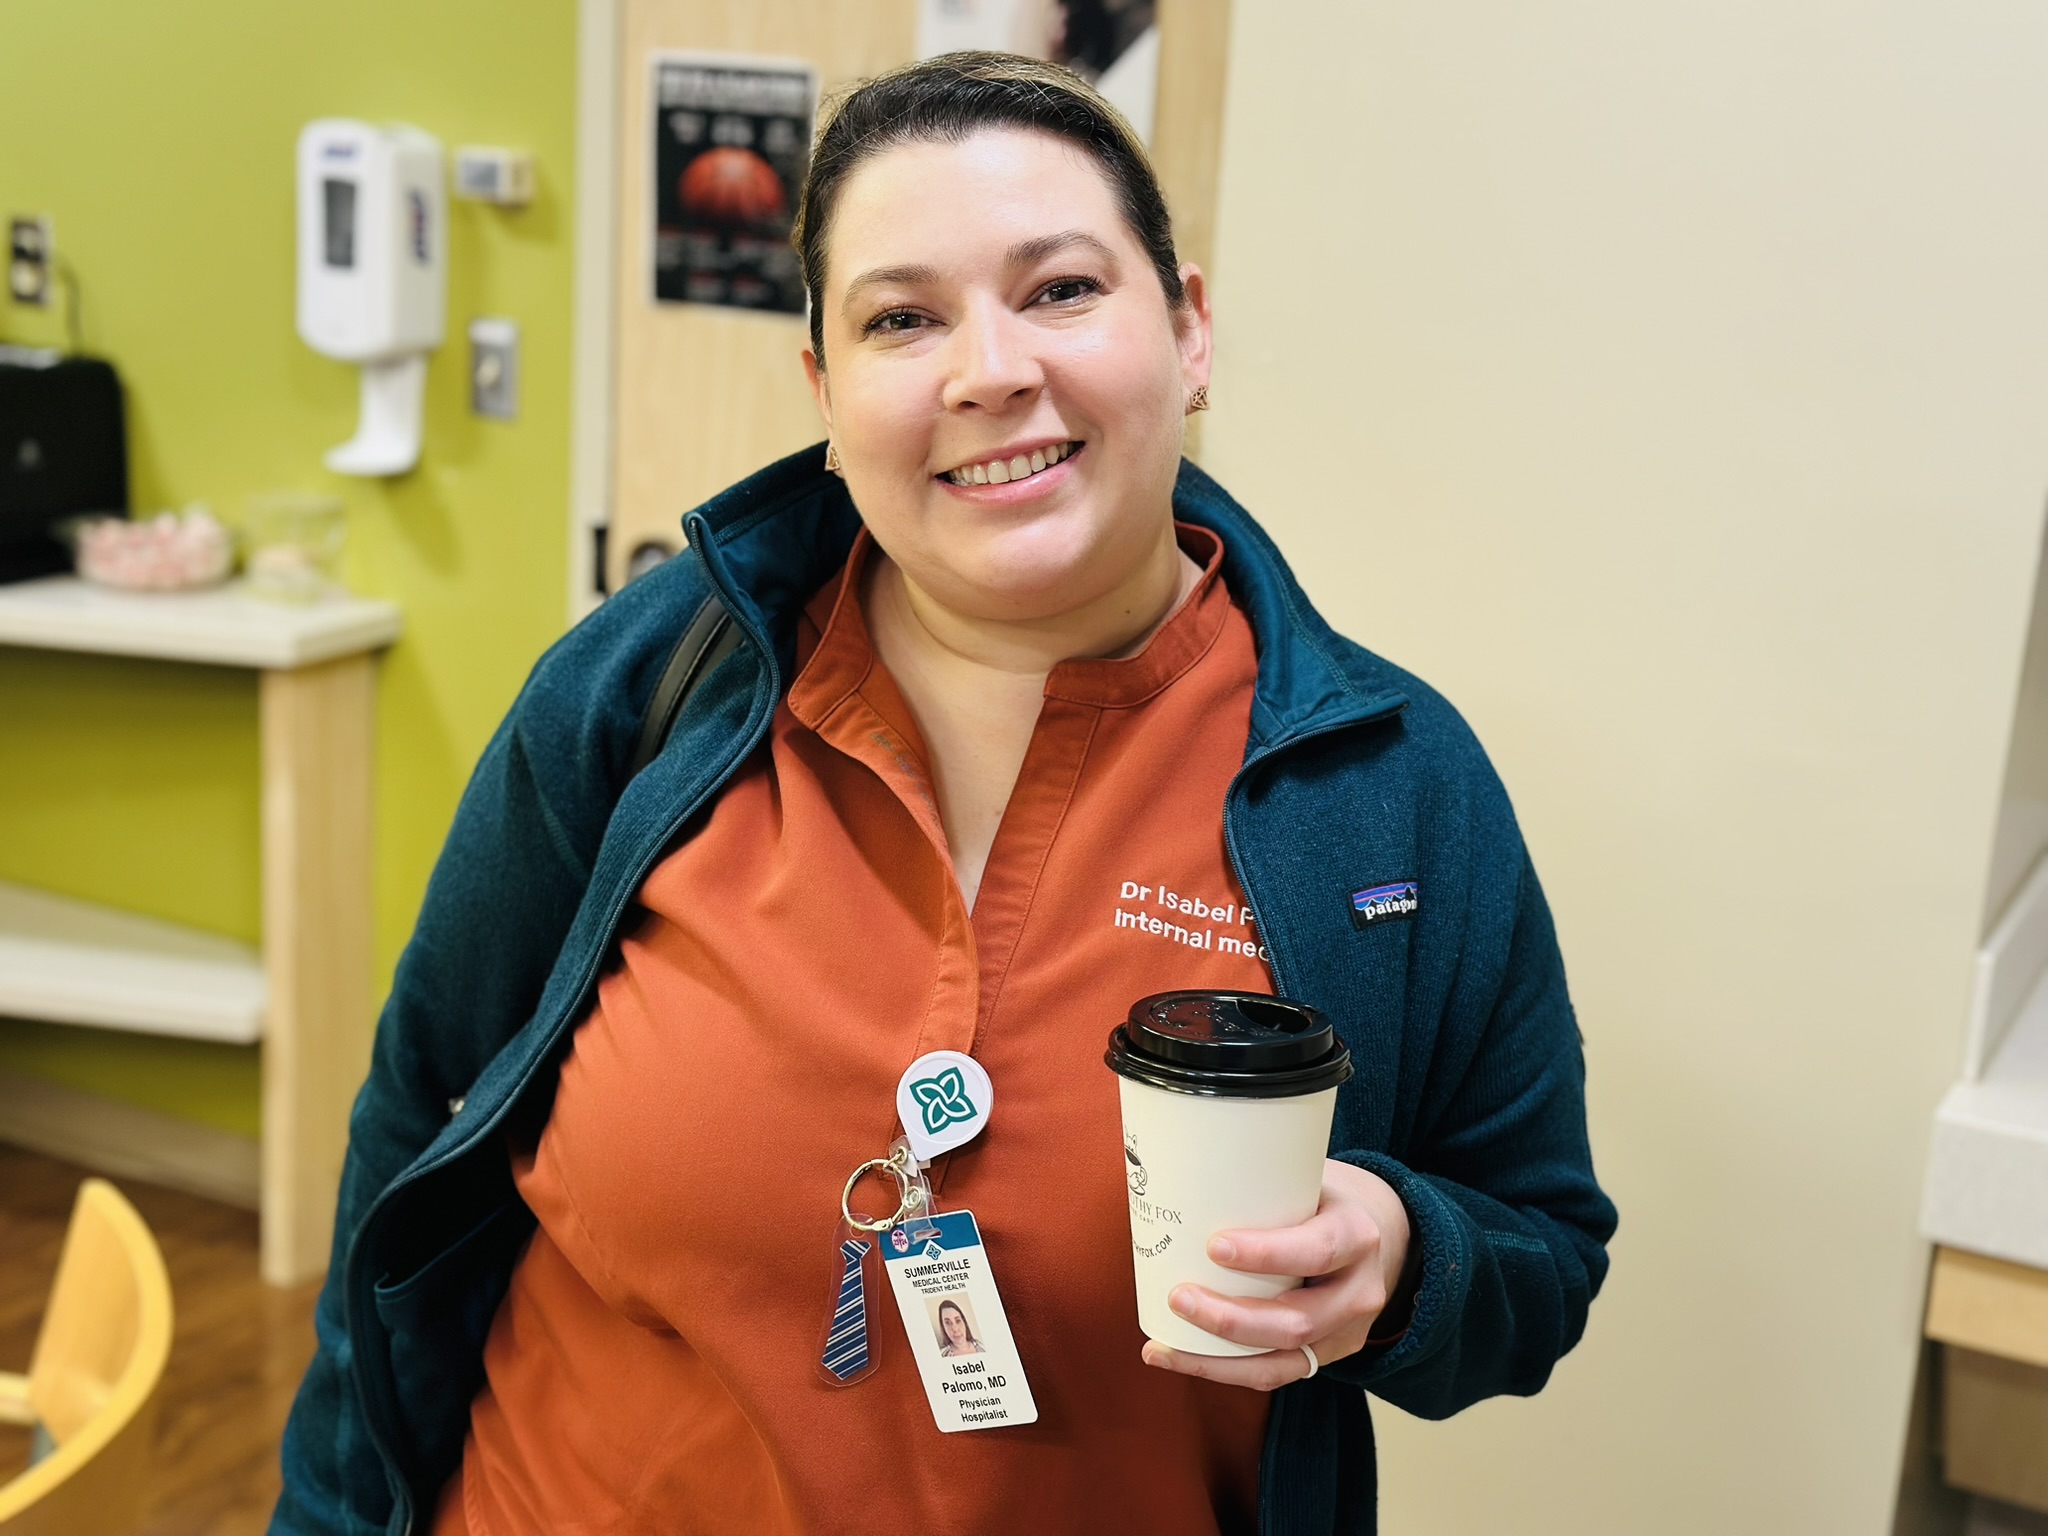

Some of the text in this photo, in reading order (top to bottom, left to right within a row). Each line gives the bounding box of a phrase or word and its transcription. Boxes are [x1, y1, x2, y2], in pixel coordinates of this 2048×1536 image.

[1120, 881, 1152, 901] Dr
[1158, 885, 1235, 924] Isabel
[1114, 908, 1212, 950] Internal
[1155, 1206, 1183, 1225] FOX
[904, 1259, 971, 1279] SUMMERVILLE
[912, 1272, 970, 1288] MEDICAL CENTER
[921, 1282, 967, 1295] TRIDENT HEALTH
[952, 1360, 986, 1376] Isabel
[942, 1375, 1007, 1394] Palomo, MD
[959, 1397, 1002, 1410] Physician
[961, 1409, 1009, 1423] Hospitalist
